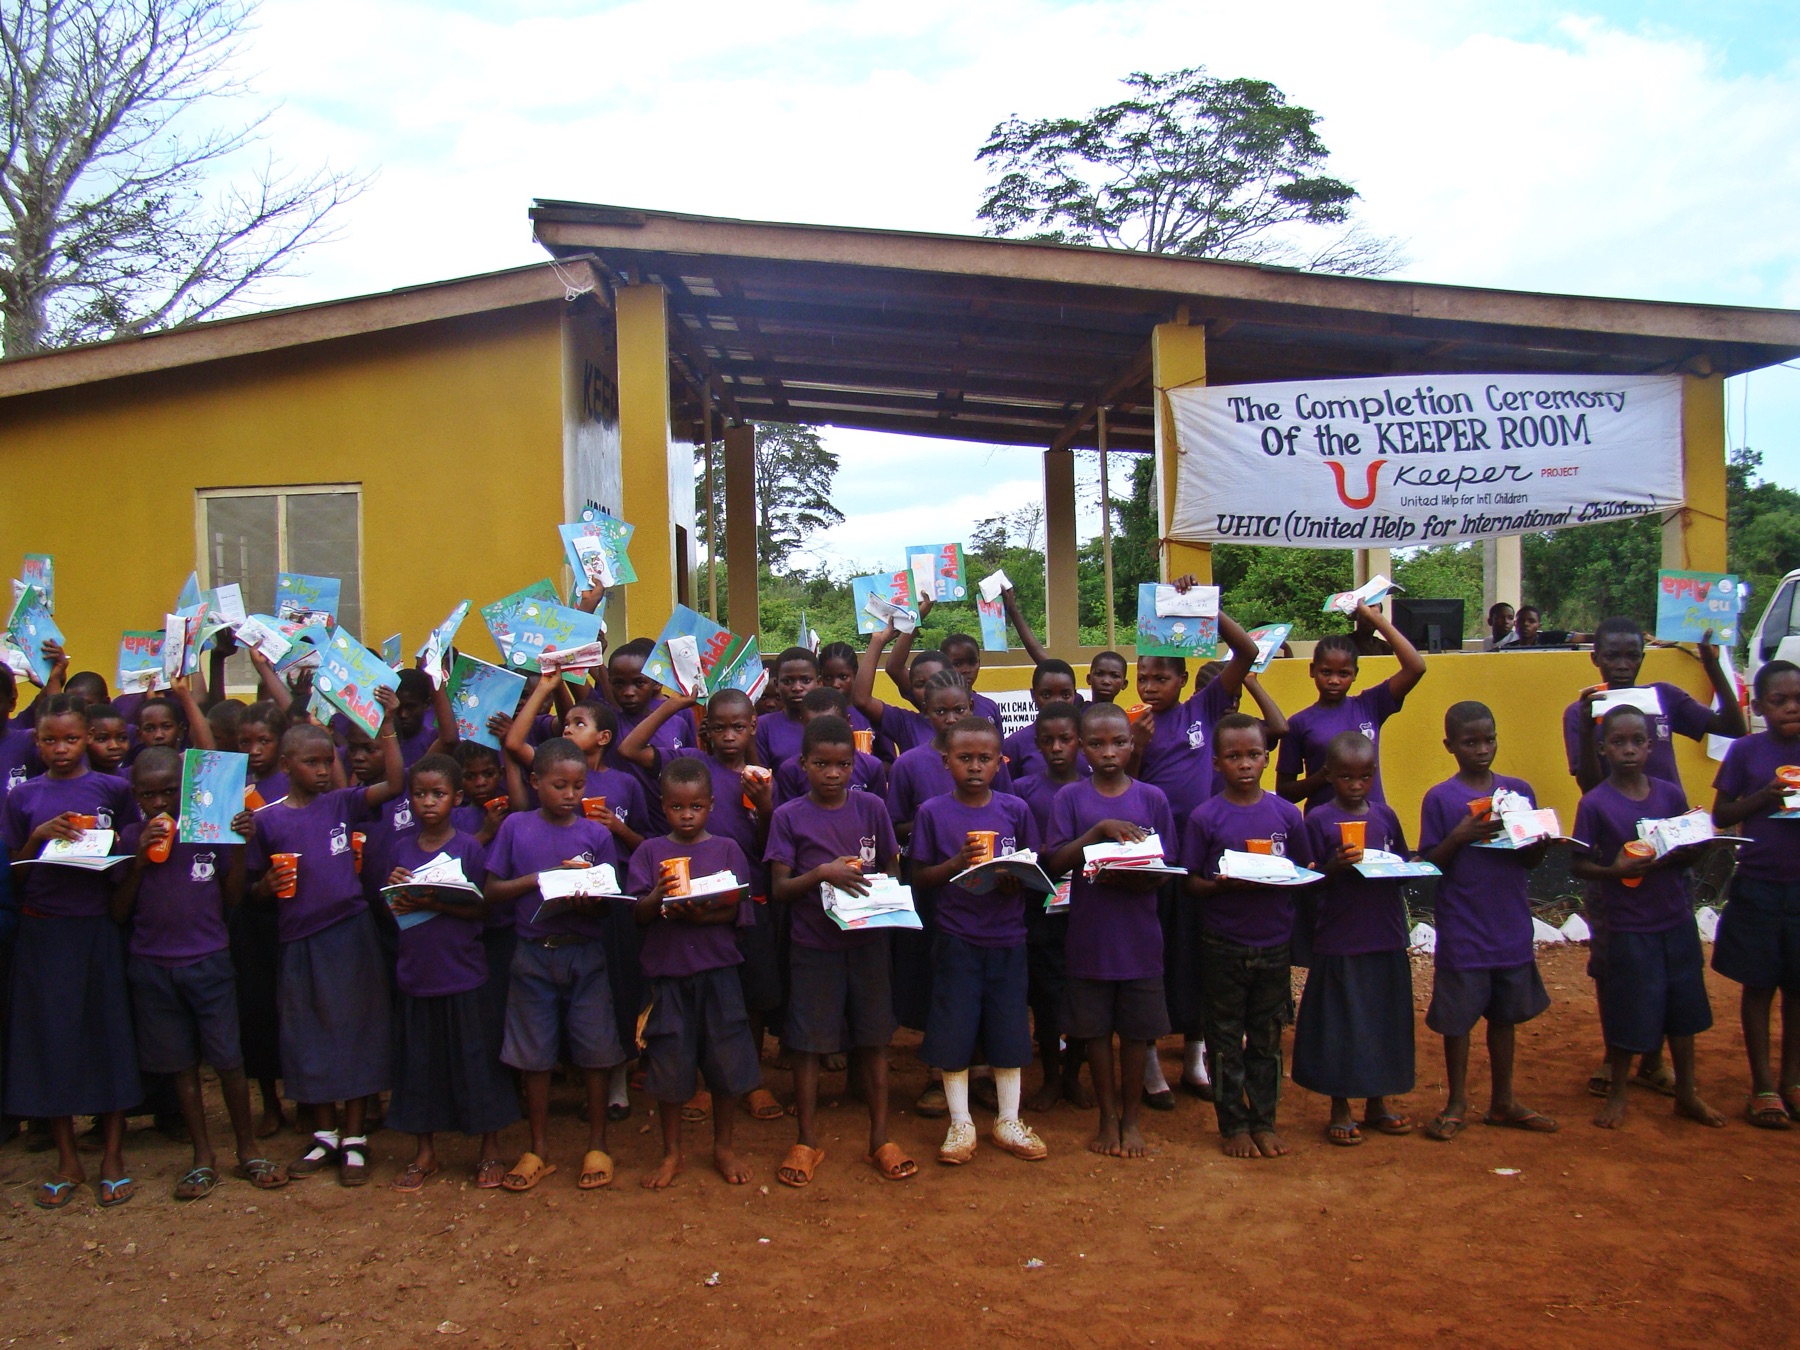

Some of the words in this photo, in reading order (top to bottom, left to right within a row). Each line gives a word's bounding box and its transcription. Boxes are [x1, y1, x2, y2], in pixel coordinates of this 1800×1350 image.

[1227, 396, 1282, 423] The
[1295, 385, 1474, 424] Completion
[1485, 384, 1626, 413] Ceremony
[1261, 425, 1301, 456] Of
[1313, 423, 1361, 456] the
[1374, 417, 1491, 455] KEEPER
[1497, 413, 1592, 450] ROOM
[1540, 466, 1580, 478] PROJECT
[1400, 495, 1438, 507] United
[1441, 494, 1459, 506] Help
[1460, 494, 1474, 505] for
[1494, 491, 1529, 505] Children
[1216, 513, 1281, 538] UHIC
[1284, 509, 1368, 542] (United
[1370, 515, 1416, 541] Help
[1420, 514, 1457, 539] for
[1459, 505, 1574, 535] International
[939, 543, 959, 580] Aida
[890, 571, 911, 607] Aida
[937, 579, 946, 596] na
[1662, 576, 1713, 603] Aida
[1707, 599, 1731, 613] na
[522, 602, 576, 643] Alby
[123, 635, 166, 657] Aida
[522, 631, 546, 648] na
[331, 635, 379, 687] Alby
[700, 631, 735, 678] Aida
[328, 659, 349, 682] na
[336, 683, 382, 732] Aida
[1012, 701, 1028, 712] CHA
[1013, 714, 1029, 722] KWA
